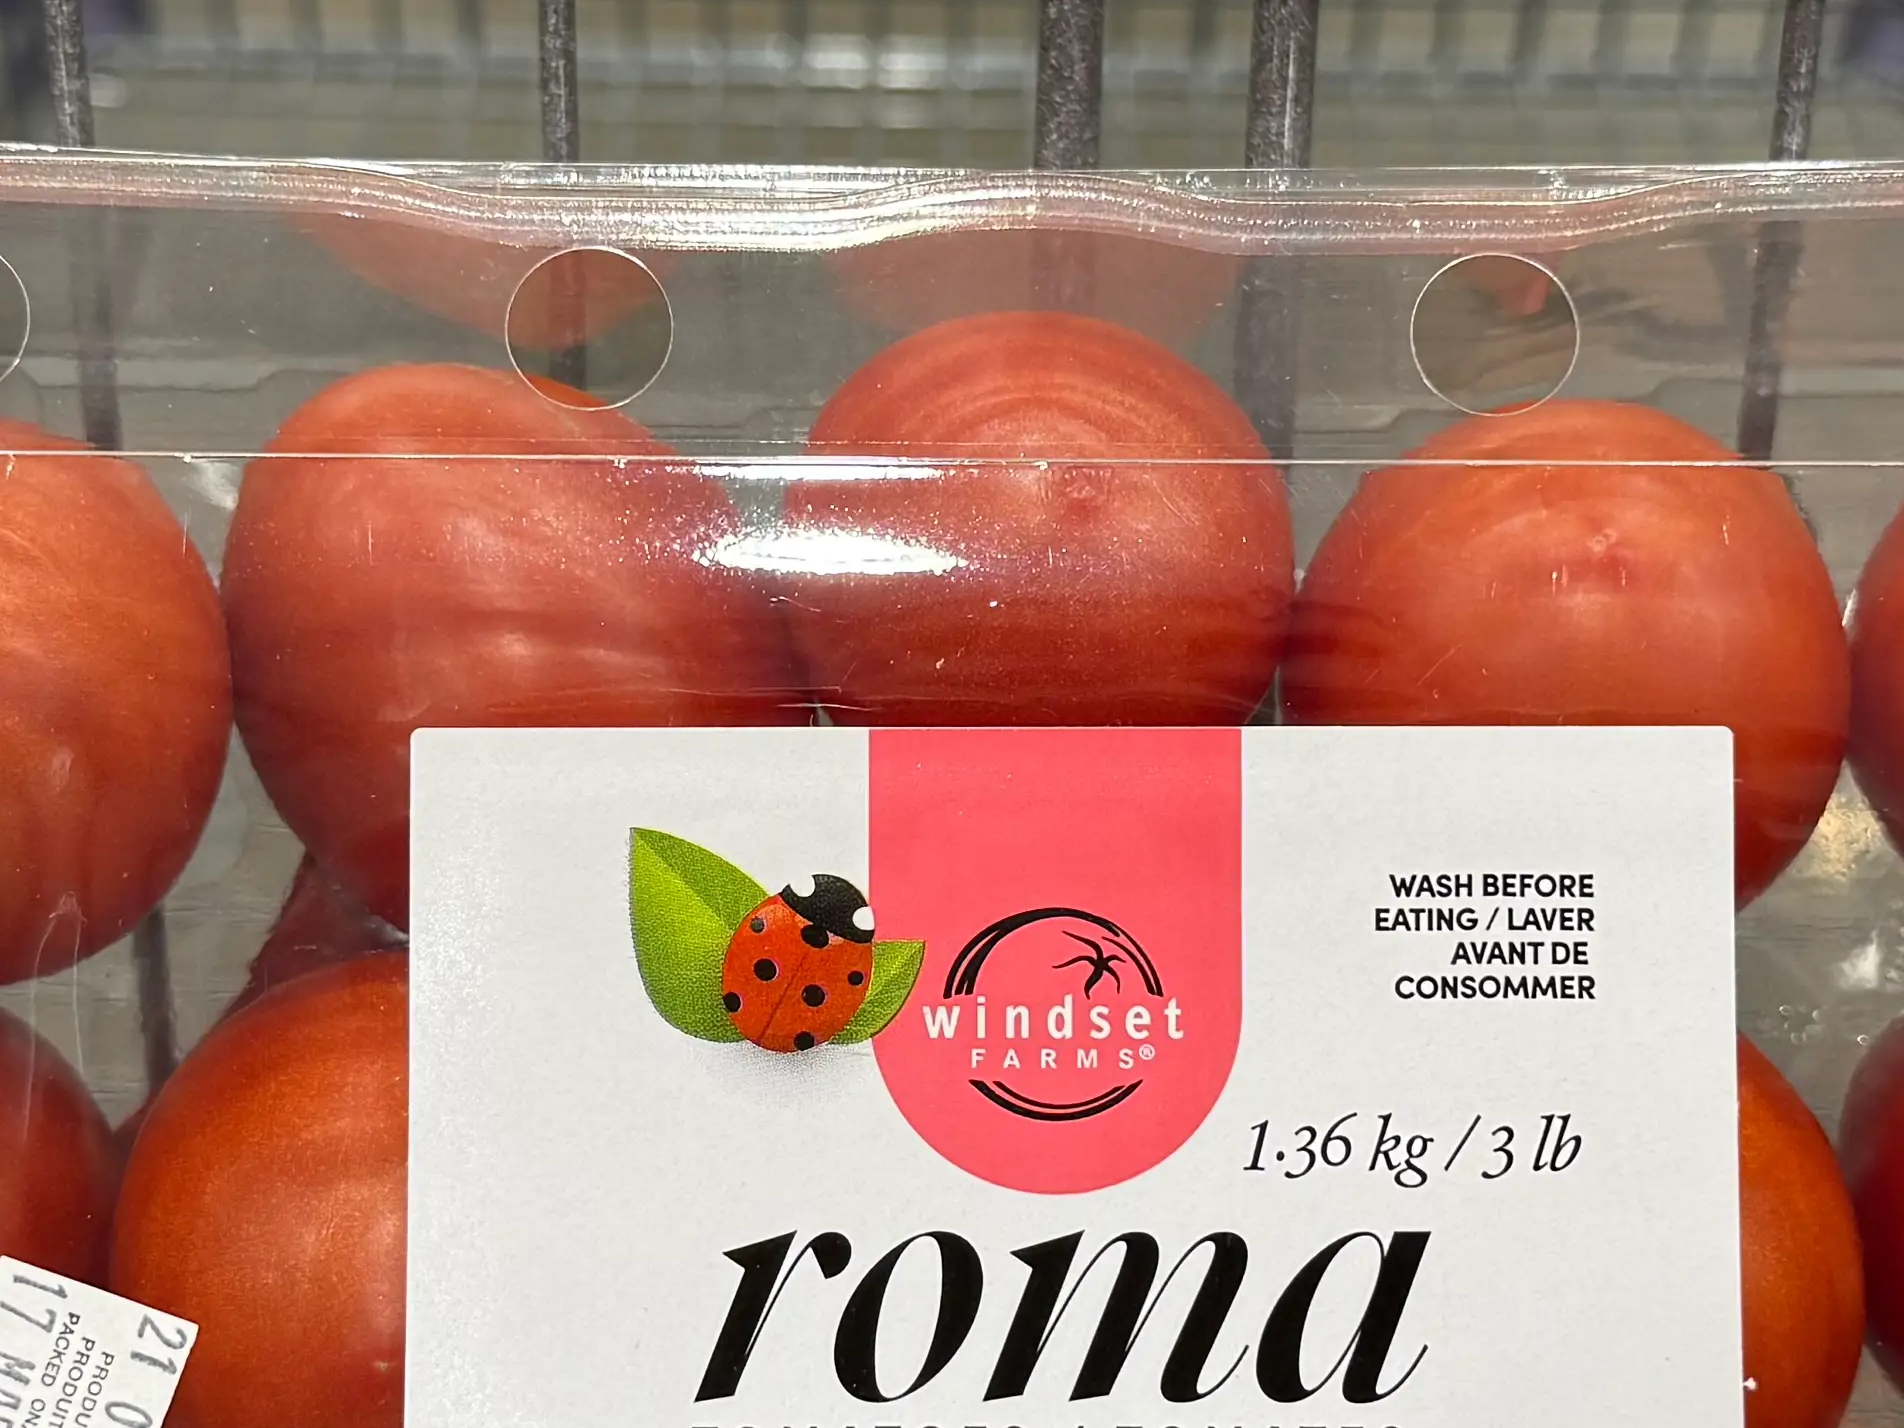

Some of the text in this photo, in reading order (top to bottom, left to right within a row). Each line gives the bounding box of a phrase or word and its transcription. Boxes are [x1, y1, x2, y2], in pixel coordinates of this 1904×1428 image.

[1389, 874, 1594, 897] WASH BEFORE
[1376, 908, 1478, 931] EATING
[1508, 908, 1594, 931] LAVER
[1451, 942, 1588, 965] AVANT DE
[1395, 976, 1595, 999] CONSOMMER
[923, 994, 1183, 1039] windset
[1369, 1113, 1434, 1188] kg
[1482, 1126, 1514, 1179] 3
[1533, 1114, 1581, 1171] lb
[0, 1274, 68, 1334] 17
[694, 1230, 1431, 1403] roma
[40, 1311, 81, 1388] PACKED
[131, 1314, 187, 1375] 21
